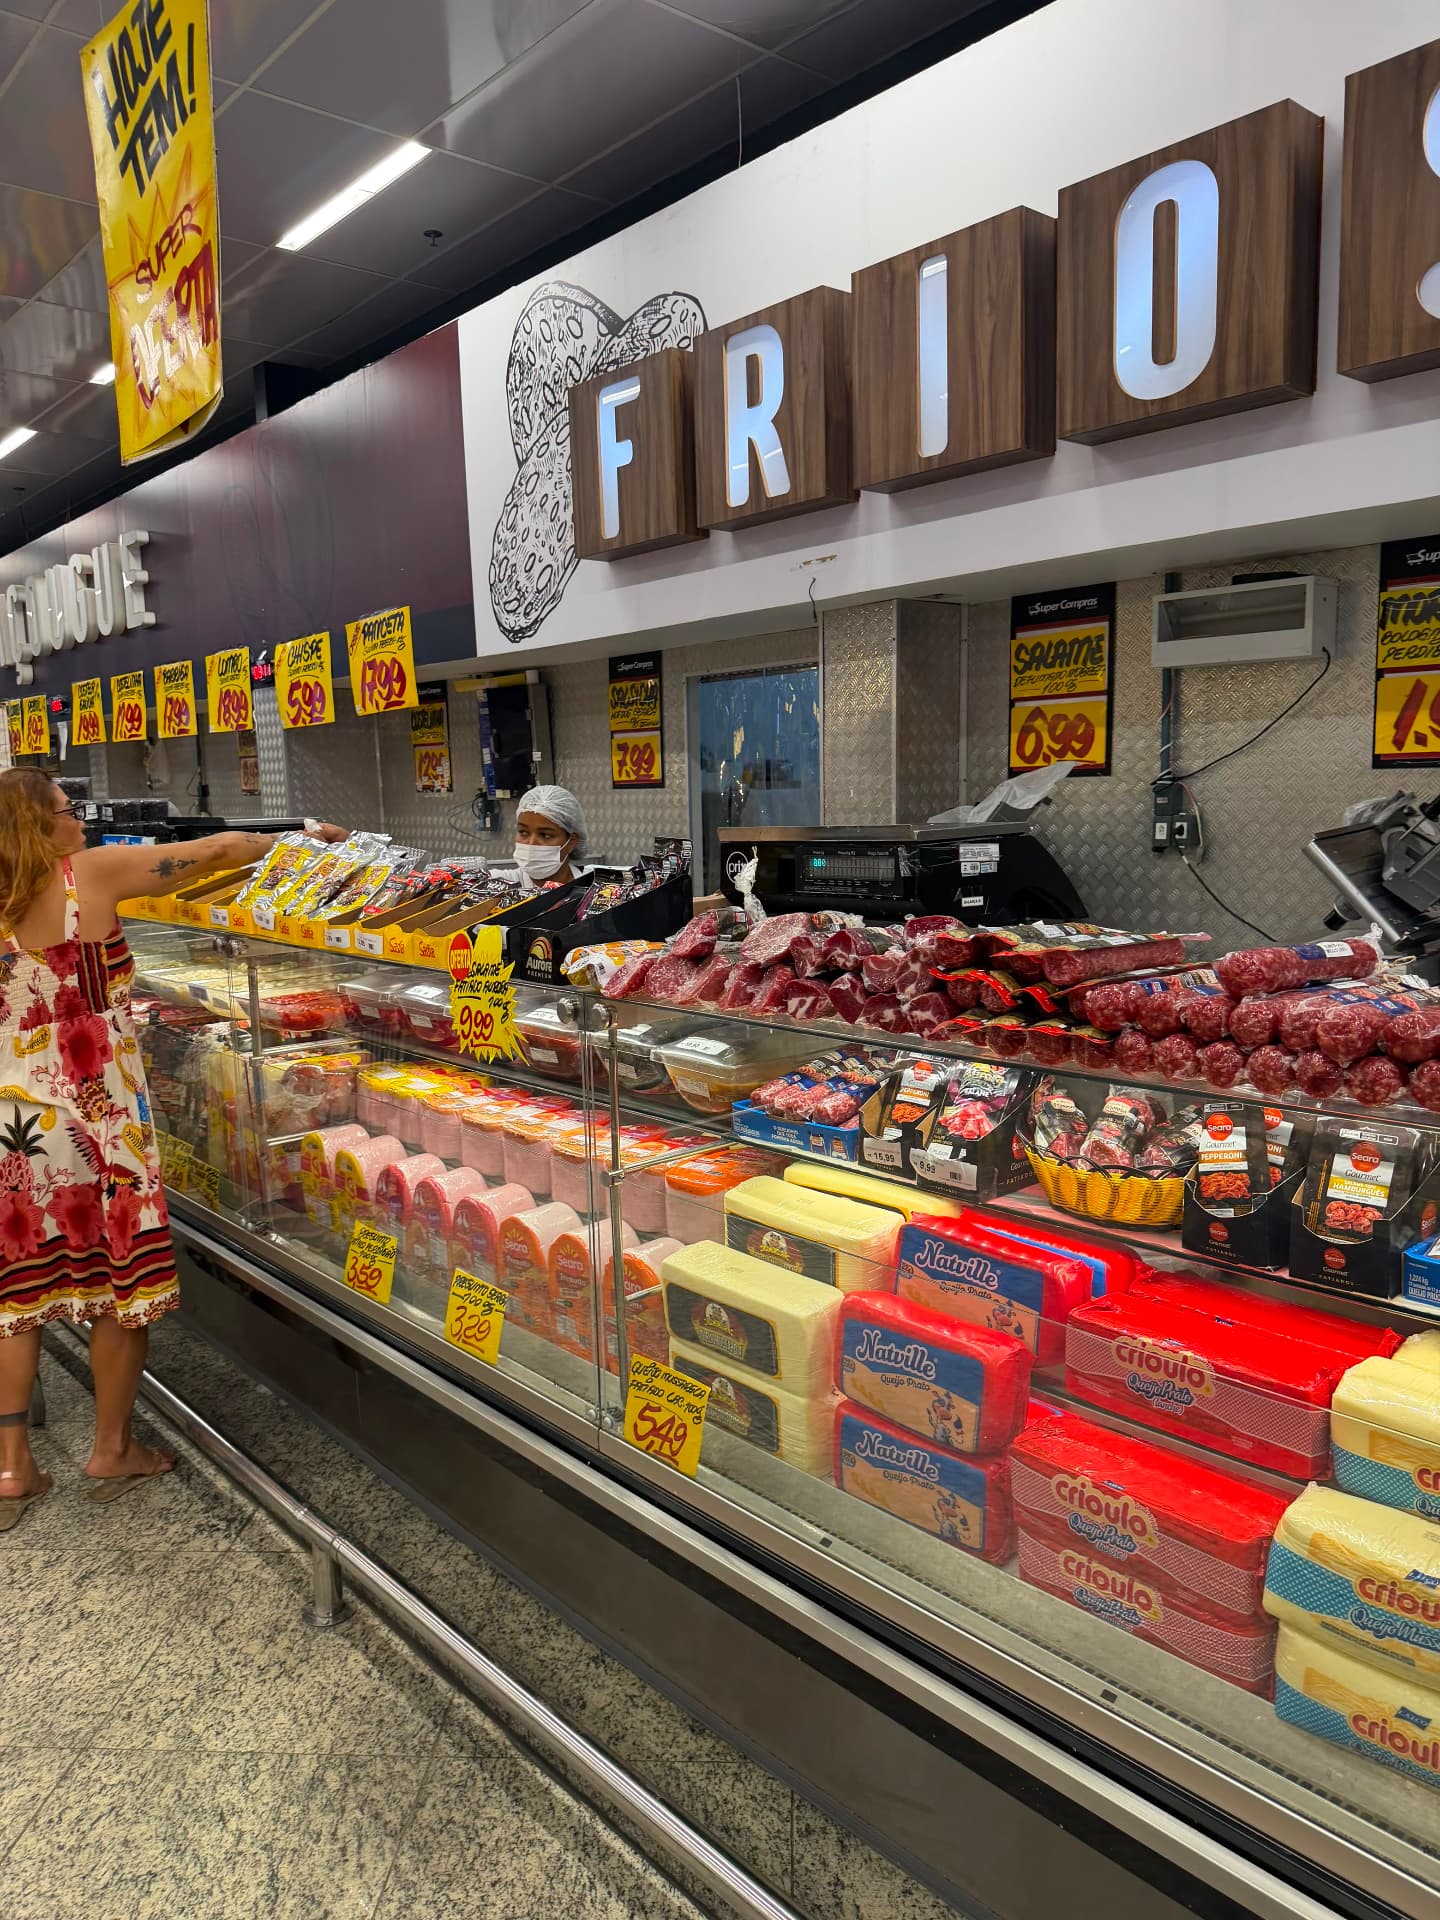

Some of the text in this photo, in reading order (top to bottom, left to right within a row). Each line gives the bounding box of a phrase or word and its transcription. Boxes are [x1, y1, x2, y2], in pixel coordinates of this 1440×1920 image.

[97, 0, 172, 151] HOJE
[119, 23, 197, 198] TEM!
[135, 203, 202, 304] SUPER
[599, 106, 1440, 540] FRIO
[287, 638, 323, 667] CHISPE
[1013, 634, 1105, 675] SALAME
[1016, 706, 1096, 764] 6,99
[616, 742, 655, 779] 7,99
[451, 949, 472, 969] OFERTA
[1206, 1141, 1235, 1149] Gourmet
[1207, 1124, 1232, 1133] Seara
[1201, 1152, 1242, 1161] PEPPERONI
[1351, 1152, 1380, 1164] Seara
[1333, 1183, 1385, 1198] HAMBURGUÊS
[1345, 1169, 1382, 1182] Gourmet
[504, 1238, 529, 1254] Seara
[556, 1254, 584, 1271] Seara
[347, 1256, 383, 1289] 3,59
[915, 1240, 998, 1290] Natville
[450, 1305, 491, 1343] 3,29
[857, 1330, 936, 1380] Natville
[1115, 1341, 1206, 1388] crioulo
[881, 1375, 931, 1391] Queijo Prato
[1128, 1374, 1194, 1405] Queijo Prato
[634, 1402, 688, 1457] 5,49
[856, 1431, 940, 1481] Natville
[883, 1470, 909, 1485] Queijo
[1055, 1481, 1148, 1537] crioulo
[1070, 1514, 1136, 1551] Queijo Prato
[1063, 1556, 1153, 1612] crioulo
[1354, 1613, 1398, 1637] Queijo
